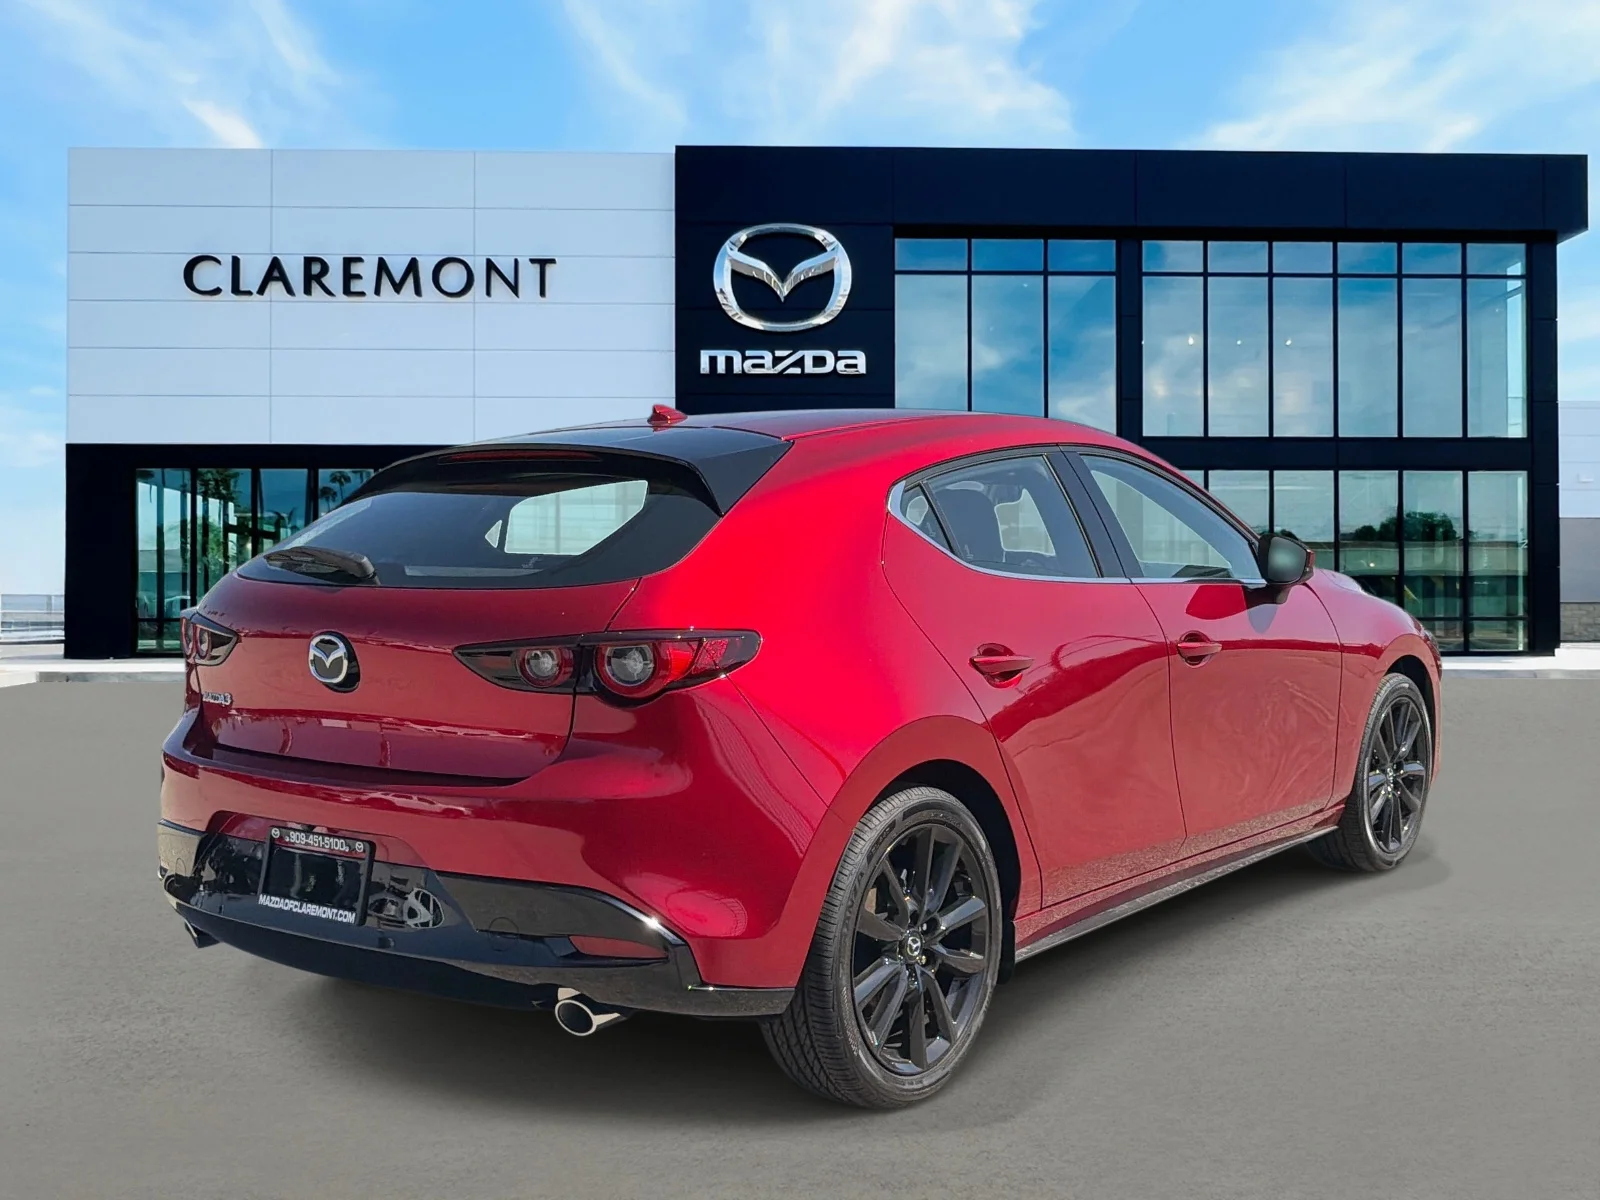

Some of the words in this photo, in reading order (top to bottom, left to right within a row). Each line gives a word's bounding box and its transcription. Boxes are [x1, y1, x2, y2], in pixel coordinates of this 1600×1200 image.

[183, 254, 557, 299] CLAREMONT
[289, 831, 346, 851] 909-451-5100
[258, 893, 356, 924] MAZDAOFCLAREMONT.COM
